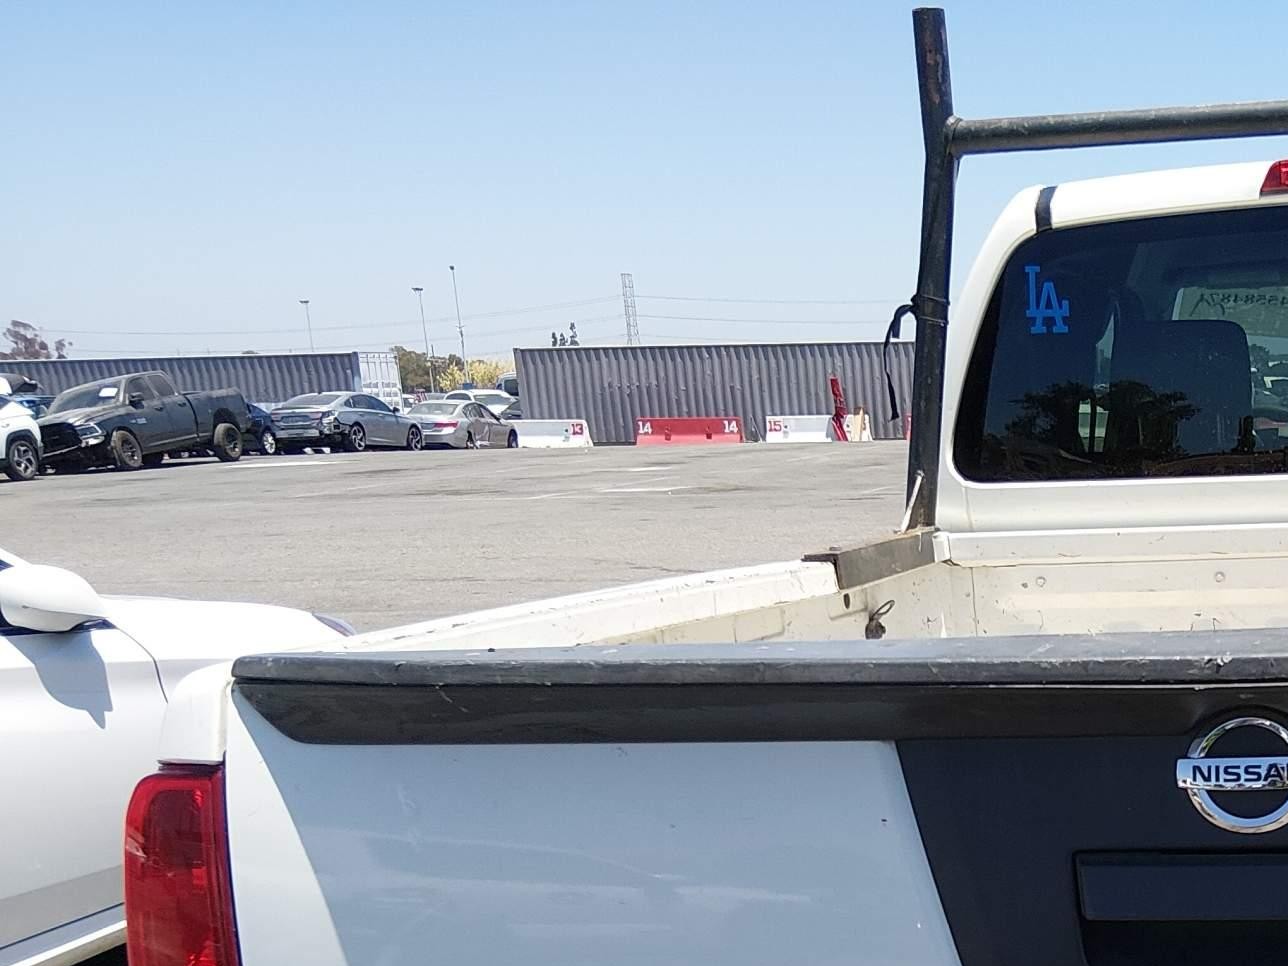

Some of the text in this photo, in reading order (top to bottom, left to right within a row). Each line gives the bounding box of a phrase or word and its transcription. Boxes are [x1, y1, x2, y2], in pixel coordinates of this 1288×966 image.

[1025, 265, 1070, 333] LA
[571, 423, 583, 435] 13
[638, 421, 652, 434] 14
[724, 420, 738, 433] 14
[768, 420, 782, 432] 15
